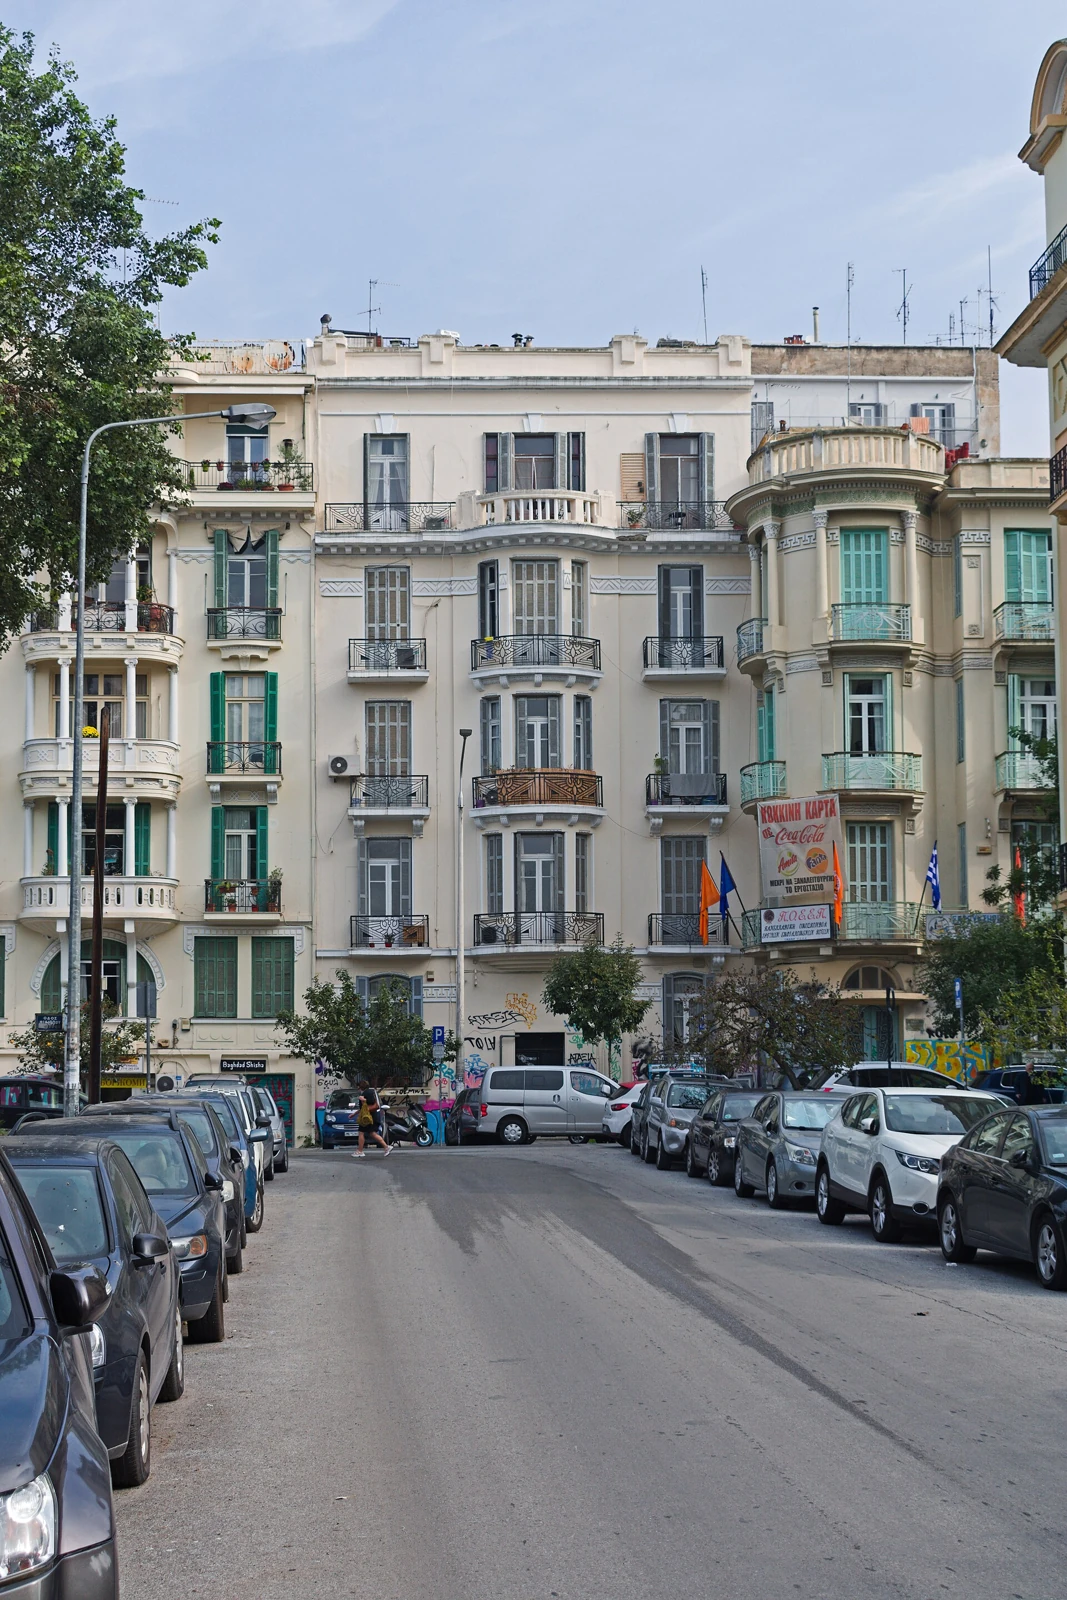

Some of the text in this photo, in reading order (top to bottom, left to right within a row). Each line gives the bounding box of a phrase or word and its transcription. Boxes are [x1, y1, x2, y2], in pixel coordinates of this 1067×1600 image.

[761, 799, 836, 824] ΚΟΚΚΙΝΗ ΚΑΡΤΑ
[778, 853, 798, 873] Amita
[806, 853, 827, 869] Fanta
[785, 884, 824, 894] ΤΟ ΕΡΓΟΣΤΑΣΙΟ
[435, 1029, 442, 1041] P
[222, 1061, 245, 1070] Baghdad
